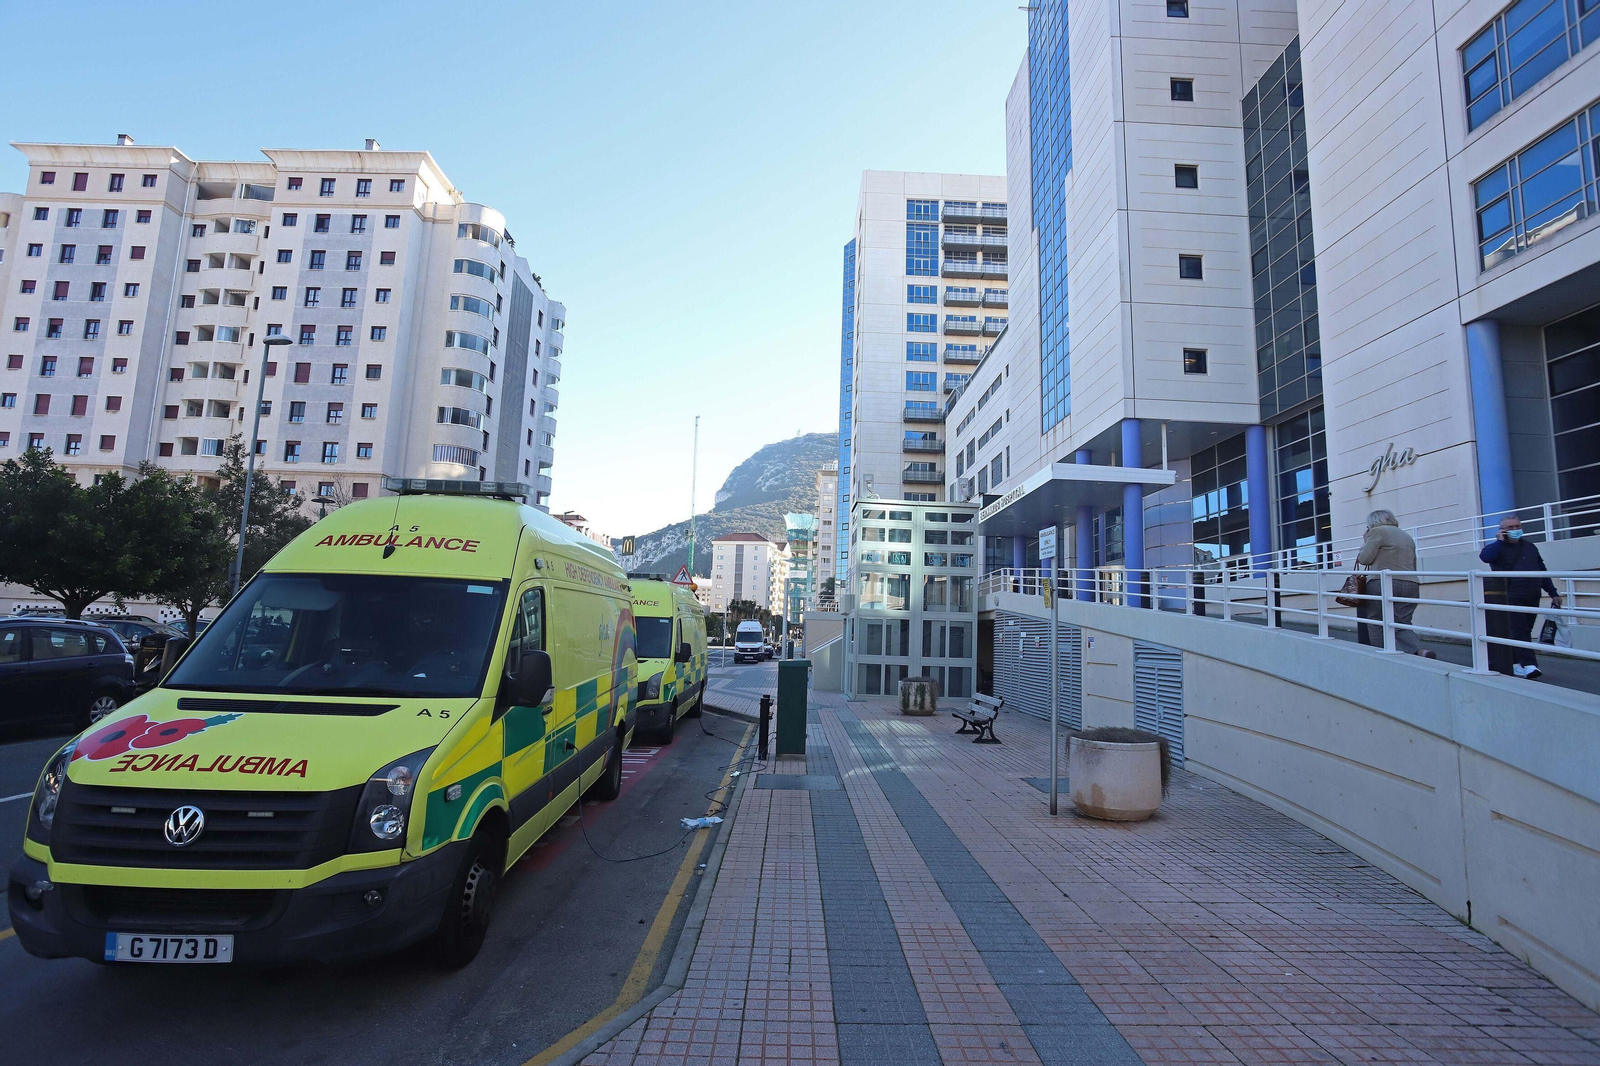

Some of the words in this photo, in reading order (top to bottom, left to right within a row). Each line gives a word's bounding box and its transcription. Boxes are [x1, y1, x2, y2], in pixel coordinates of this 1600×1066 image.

[1362, 442, 1419, 493] gha
[314, 534, 480, 553] AMBULANCE
[564, 561, 579, 580] HIGH
[416, 708, 432, 717] A
[439, 709, 451, 719] 5
[130, 937, 143, 958] G
[149, 938, 198, 959] 7173
[203, 938, 218, 959] D
